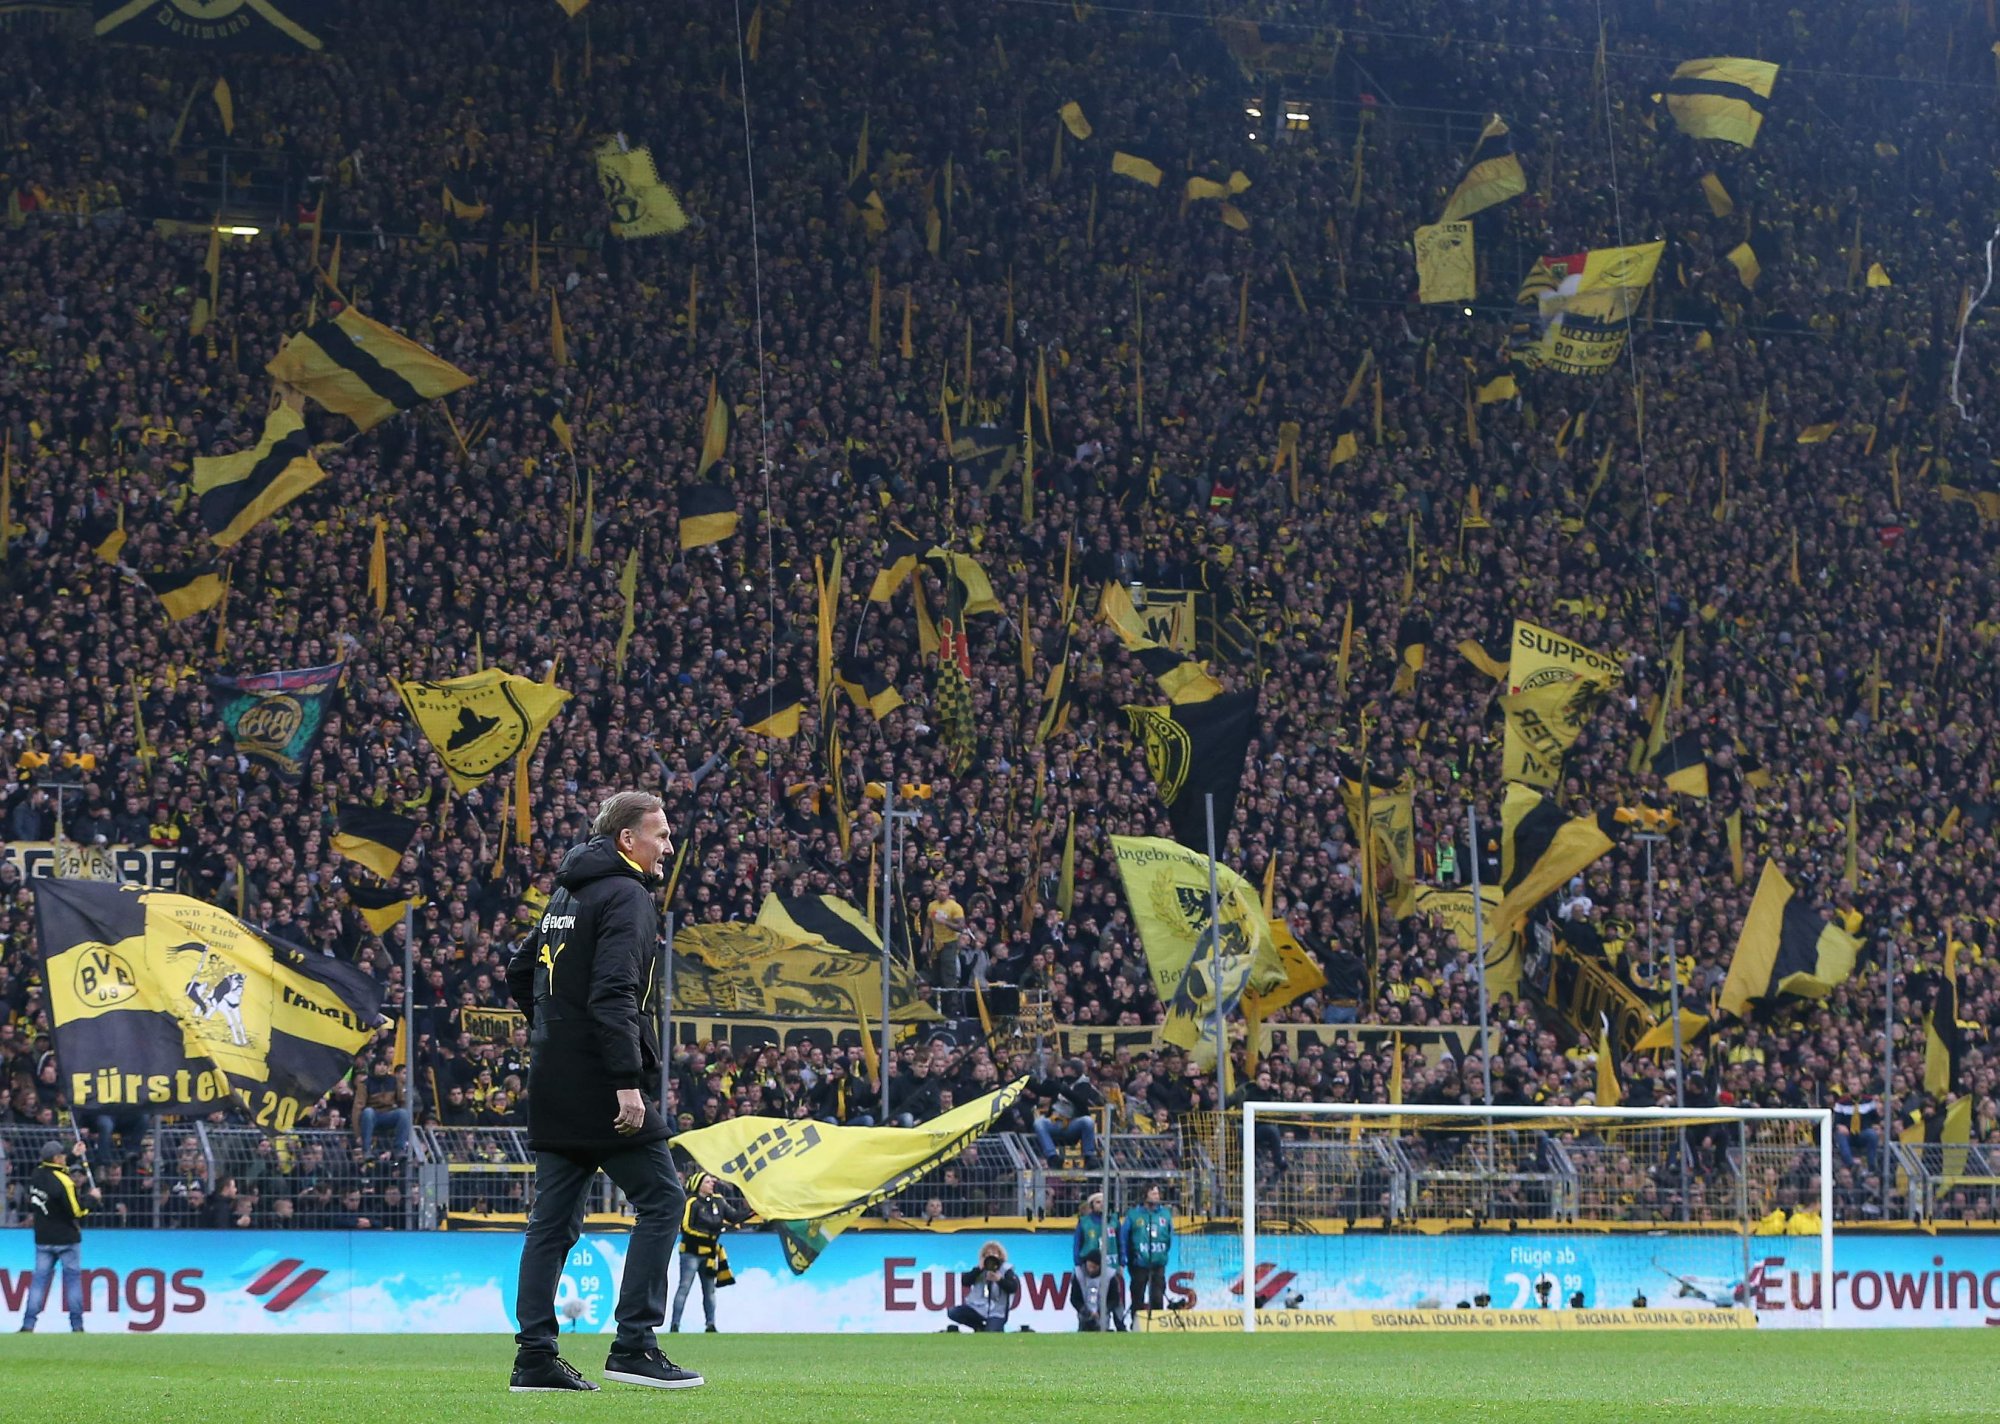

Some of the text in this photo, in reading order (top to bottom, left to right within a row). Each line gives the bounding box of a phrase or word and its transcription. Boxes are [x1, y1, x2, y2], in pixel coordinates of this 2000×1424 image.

[573, 1249, 593, 1266] ab
[1511, 1246, 1576, 1269] Flüge ab
[581, 1276, 600, 1292] 99
[1158, 1316, 1219, 1328] SIGNAL
[1295, 1315, 1336, 1326] PARK
[1371, 1314, 1541, 1326] SIGNAL IDUNA PARK
[1575, 1313, 1739, 1325] SIGNAL IDUNA PARK
